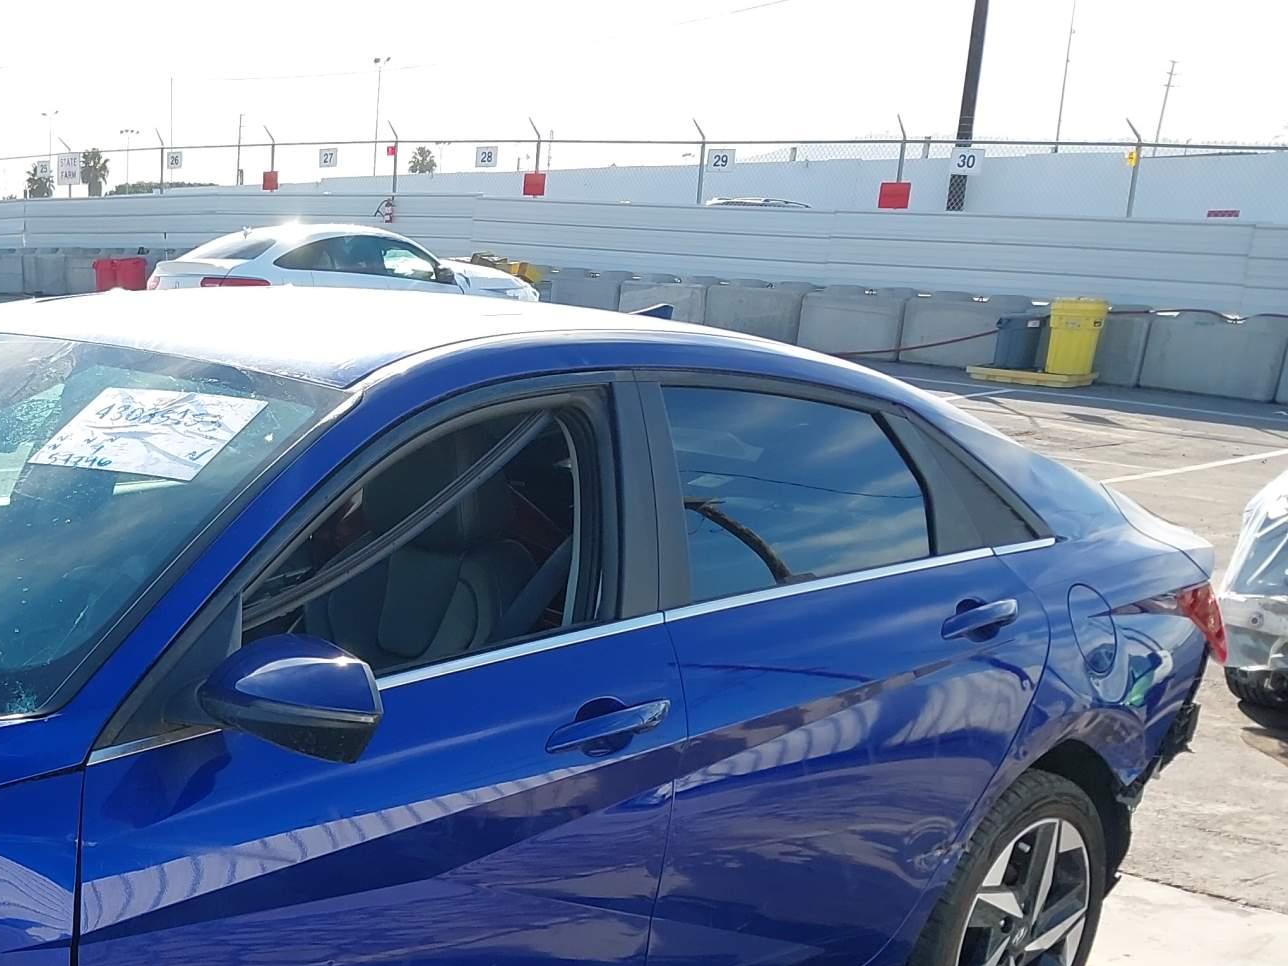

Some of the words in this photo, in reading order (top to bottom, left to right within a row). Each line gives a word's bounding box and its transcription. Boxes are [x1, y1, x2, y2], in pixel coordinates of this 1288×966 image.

[170, 156, 179, 166] 26
[323, 153, 334, 164] 27
[480, 151, 493, 163] 28
[712, 154, 729, 168] 29
[957, 154, 976, 169] 30
[60, 158, 77, 168] STATE
[60, 171, 77, 180] FARM
